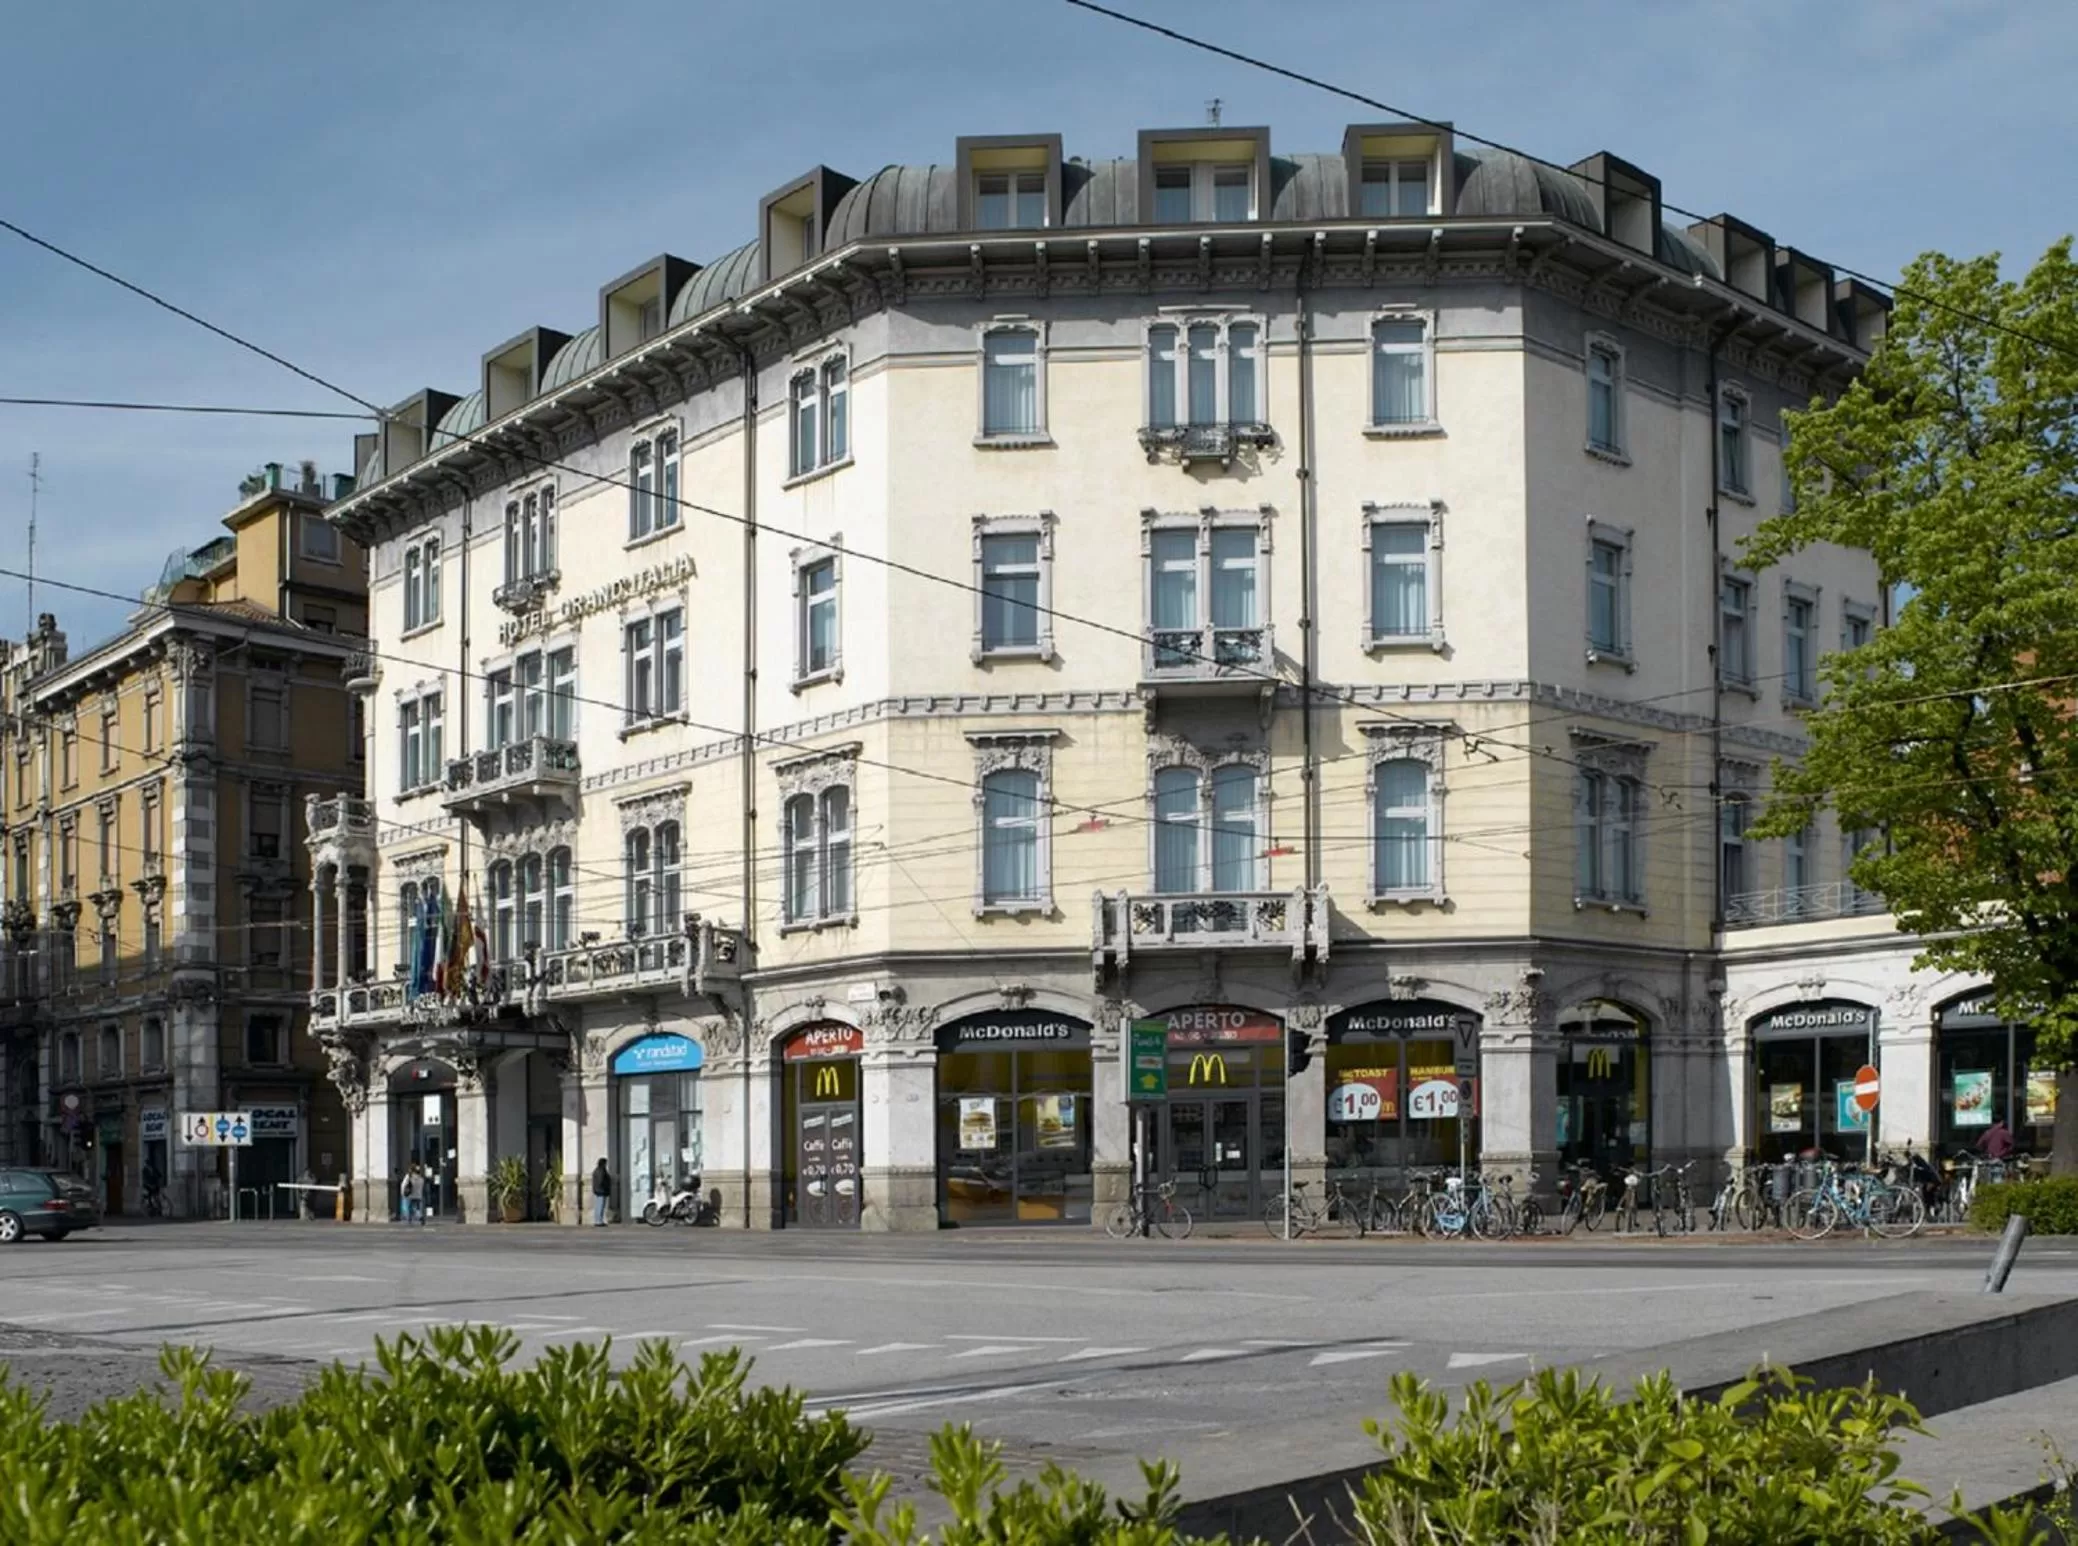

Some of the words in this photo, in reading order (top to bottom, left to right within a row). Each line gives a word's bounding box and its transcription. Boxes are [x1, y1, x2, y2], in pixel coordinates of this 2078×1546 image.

[498, 607, 554, 648] HOTEL
[1166, 1011, 1246, 1030] APERTO
[1347, 1014, 1457, 1032] McDonald's
[1770, 1009, 1866, 1029] McDonald's
[805, 1026, 853, 1046] APERTO
[959, 1023, 1070, 1040] McDonald's
[251, 1108, 296, 1119] OCAL
